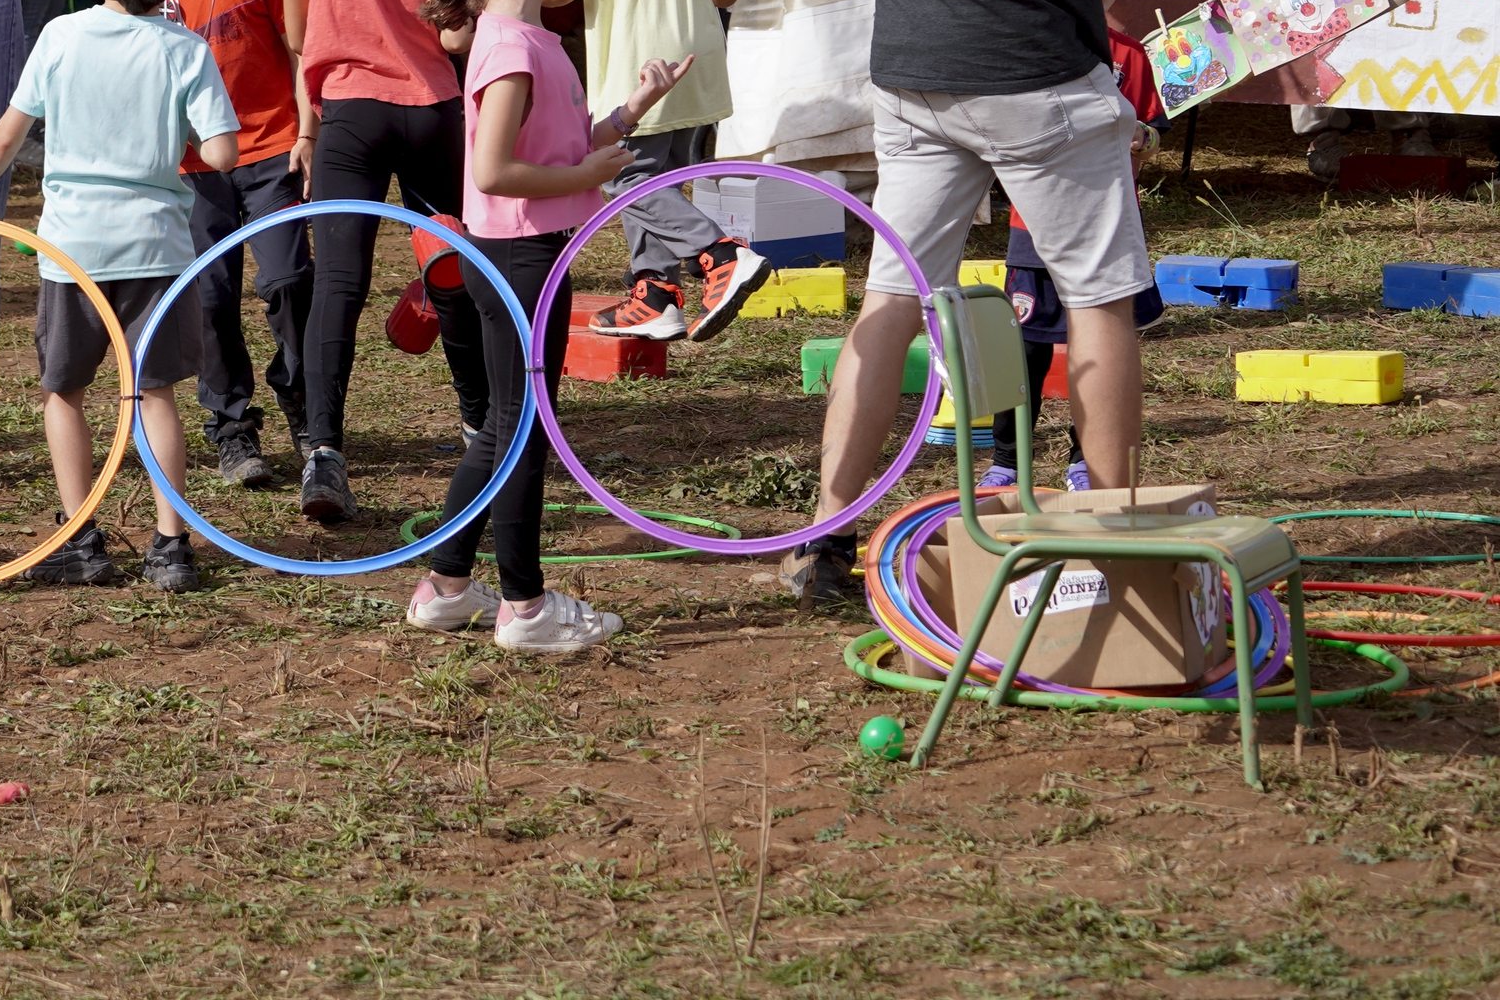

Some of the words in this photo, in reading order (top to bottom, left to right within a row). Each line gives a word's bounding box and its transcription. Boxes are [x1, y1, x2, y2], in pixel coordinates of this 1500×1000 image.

[1058, 573, 1105, 586] Nafarroa
[1059, 580, 1106, 596] OINEZ
[1060, 593, 1096, 603] Zangoza
